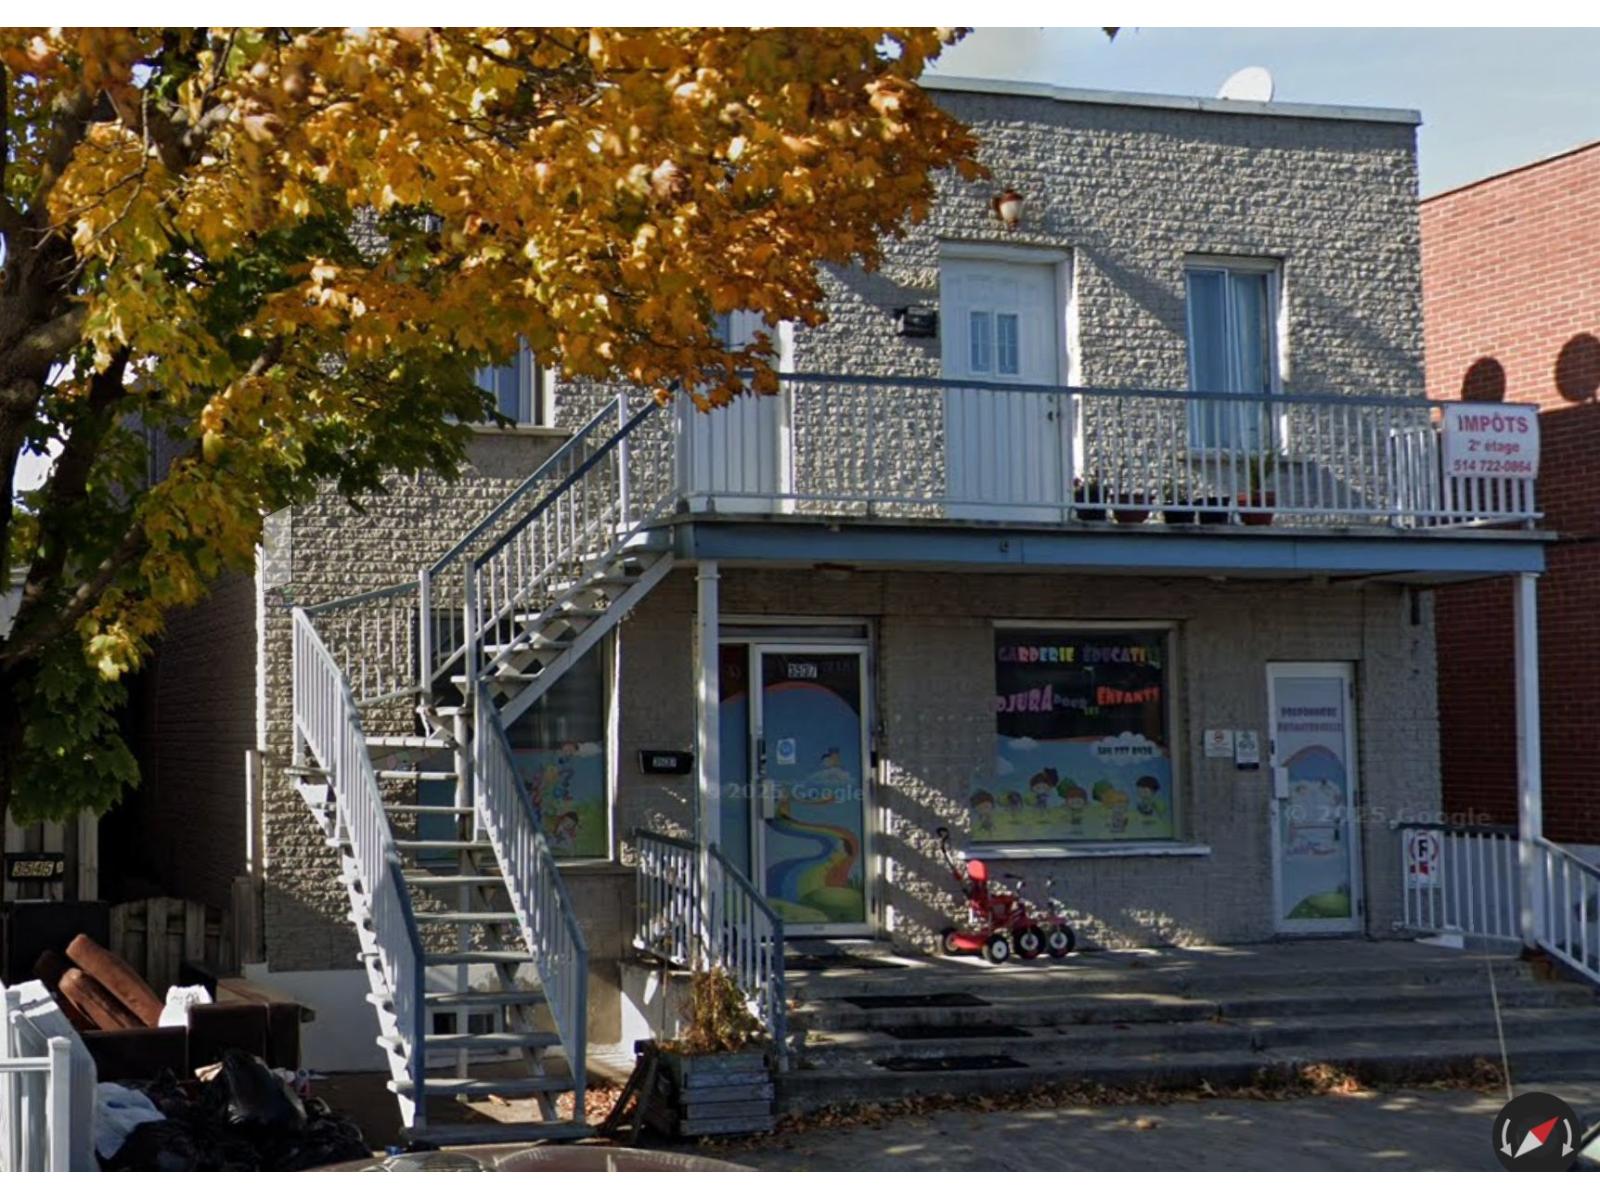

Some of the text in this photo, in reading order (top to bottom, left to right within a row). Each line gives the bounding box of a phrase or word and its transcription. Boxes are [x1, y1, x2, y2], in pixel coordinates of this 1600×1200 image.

[1457, 411, 1529, 433] IMPÔTS
[1485, 440, 1520, 455] étage
[1454, 460, 1476, 472] 514
[999, 646, 1075, 663] GARDERIE
[1096, 686, 1160, 706] ENFANTS
